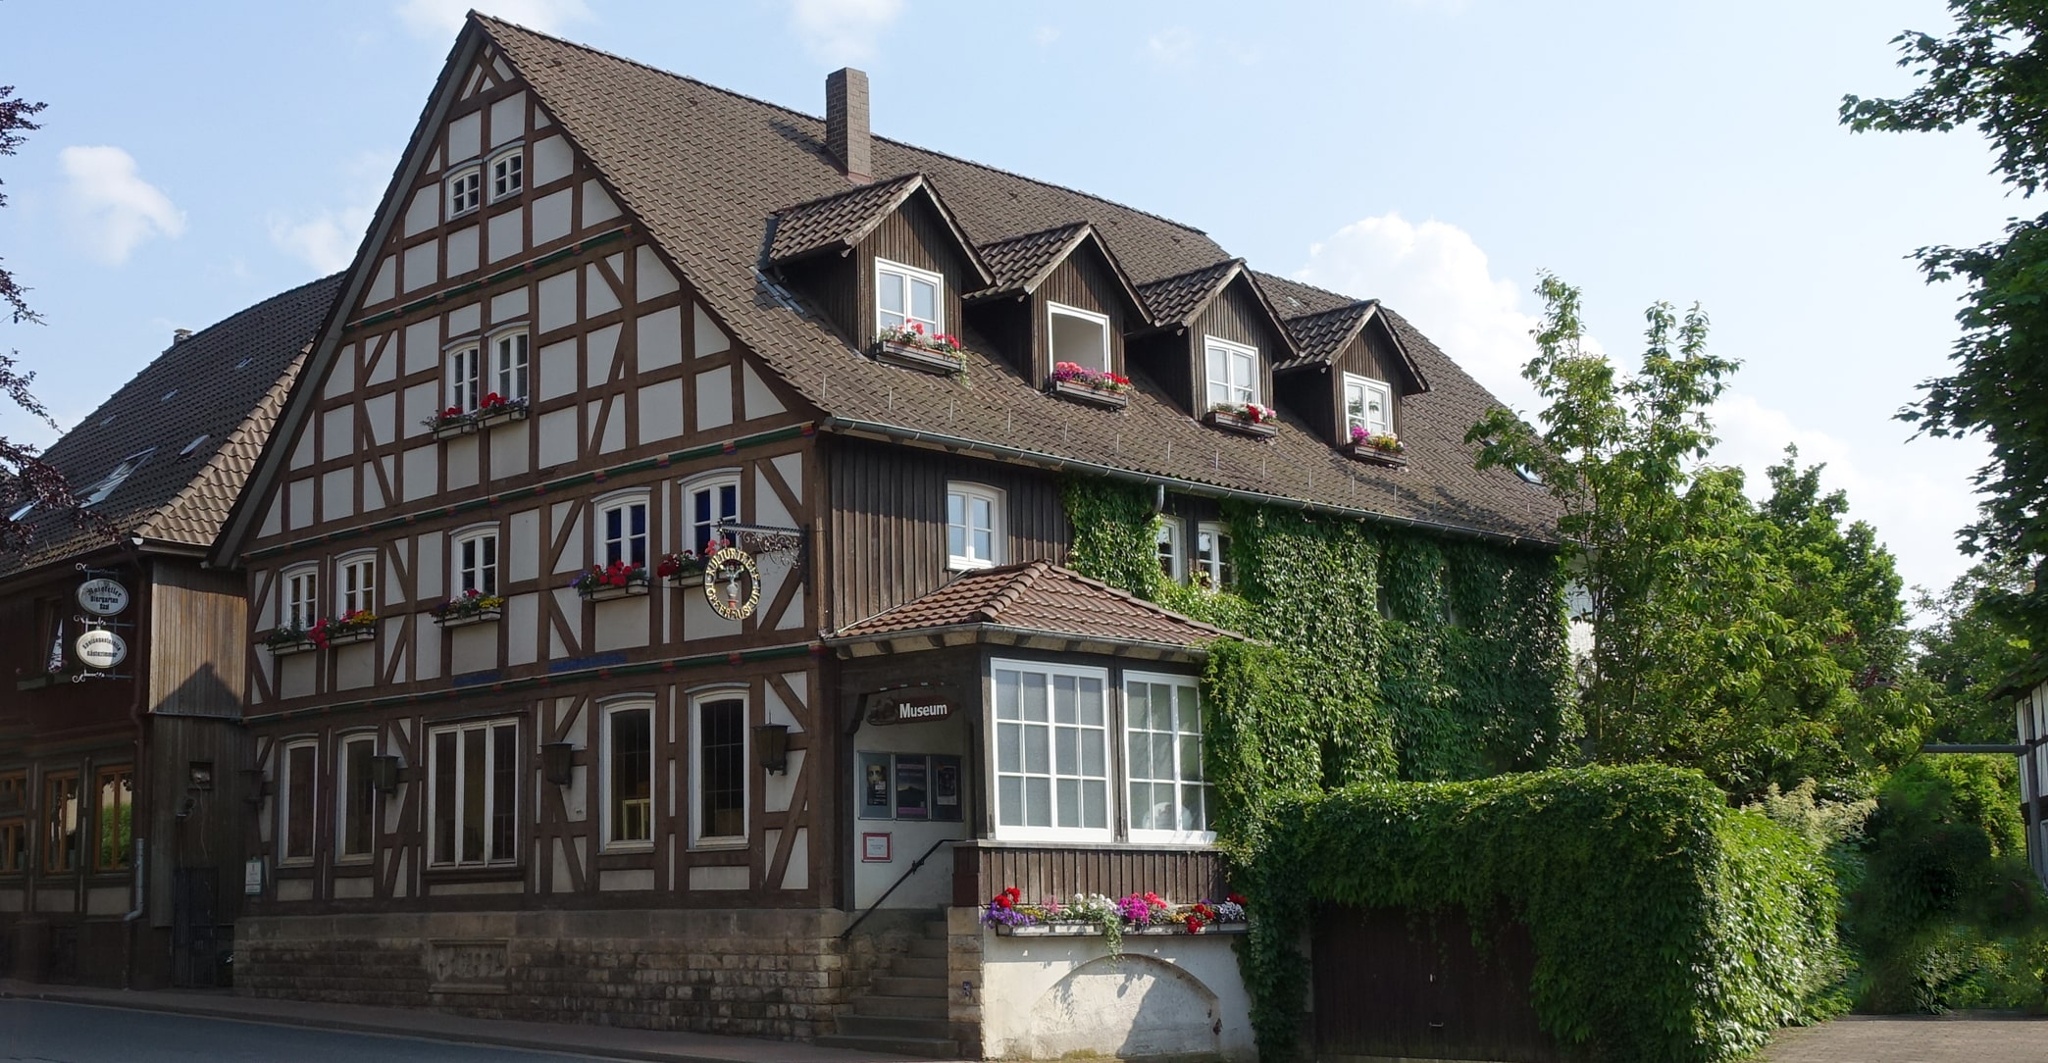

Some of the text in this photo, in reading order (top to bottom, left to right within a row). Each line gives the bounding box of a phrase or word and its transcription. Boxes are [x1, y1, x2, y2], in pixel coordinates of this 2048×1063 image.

[705, 547, 760, 580] KULTURTREFF
[90, 595, 119, 604] Biergarten
[899, 702, 948, 719] Museum
